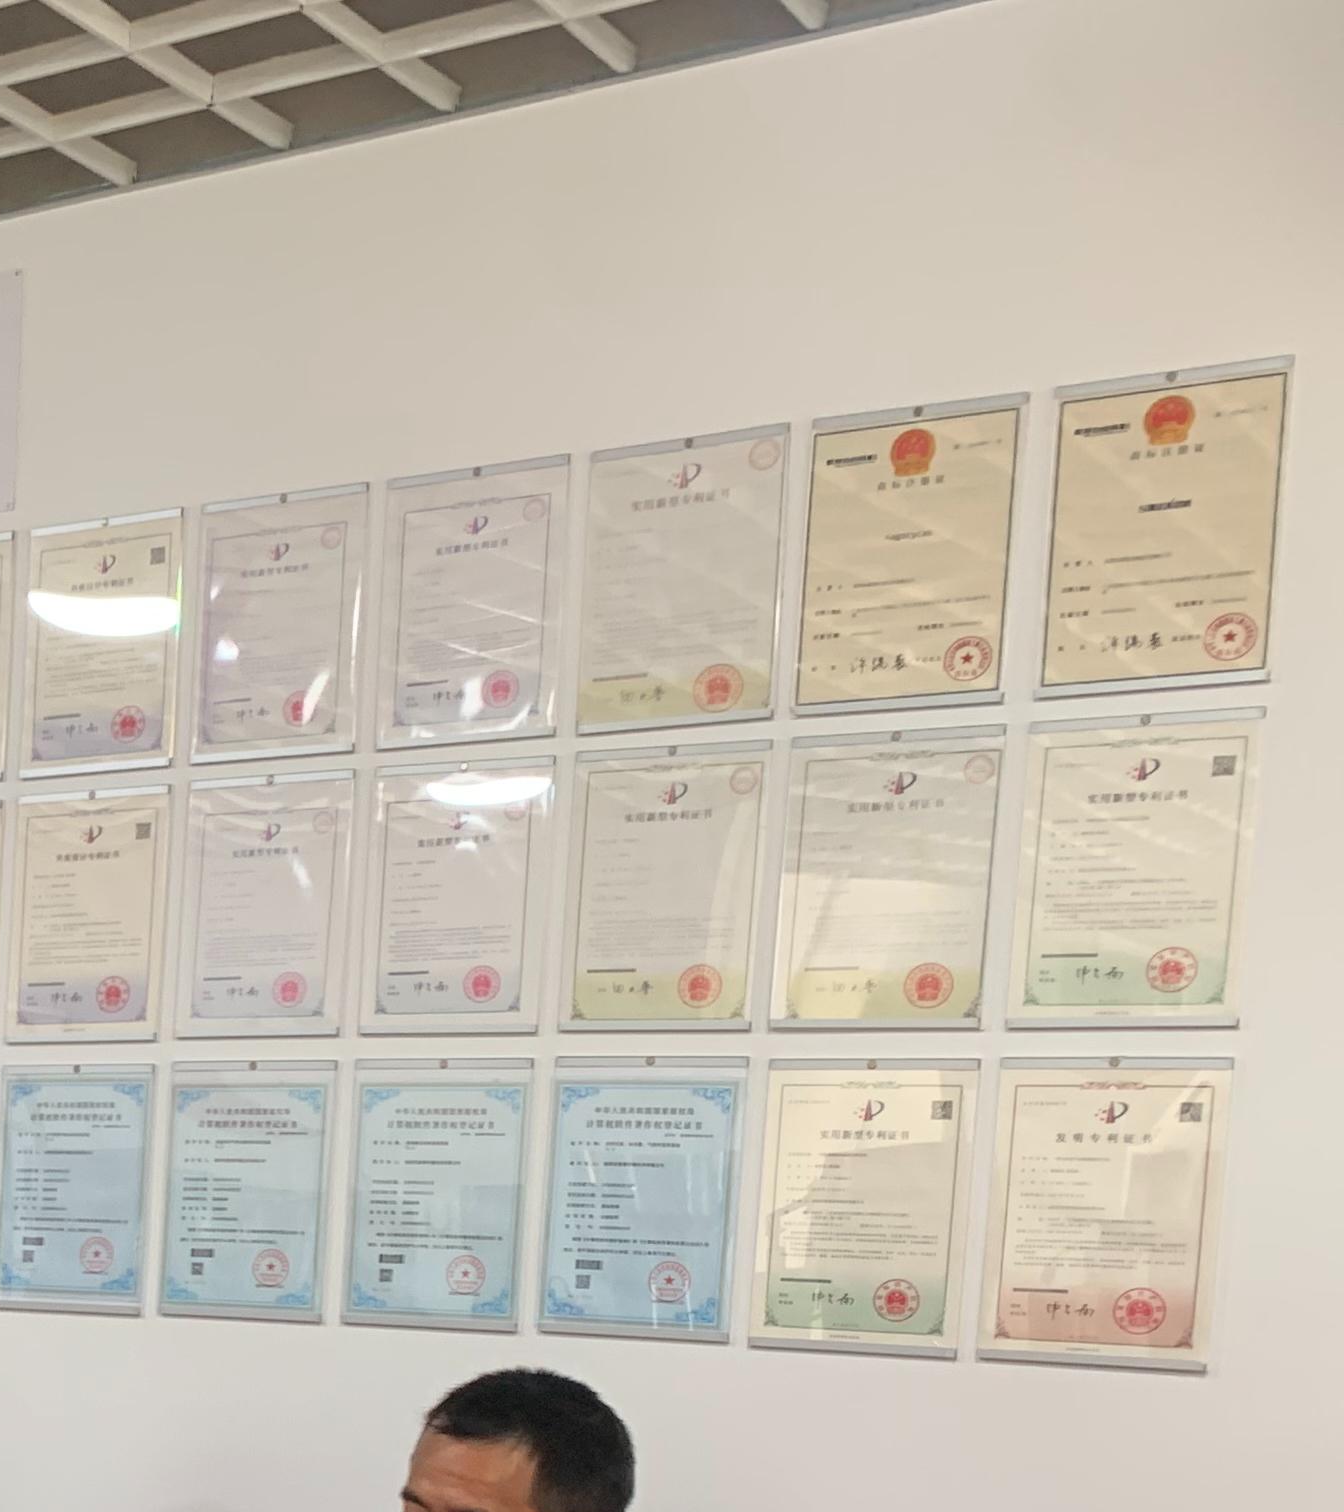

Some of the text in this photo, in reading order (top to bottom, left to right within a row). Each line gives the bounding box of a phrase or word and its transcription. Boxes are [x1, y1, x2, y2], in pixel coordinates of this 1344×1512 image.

[820, 1130, 910, 1141] 实用新型专利证书
[1055, 1133, 1153, 1144] 发明专利证书
